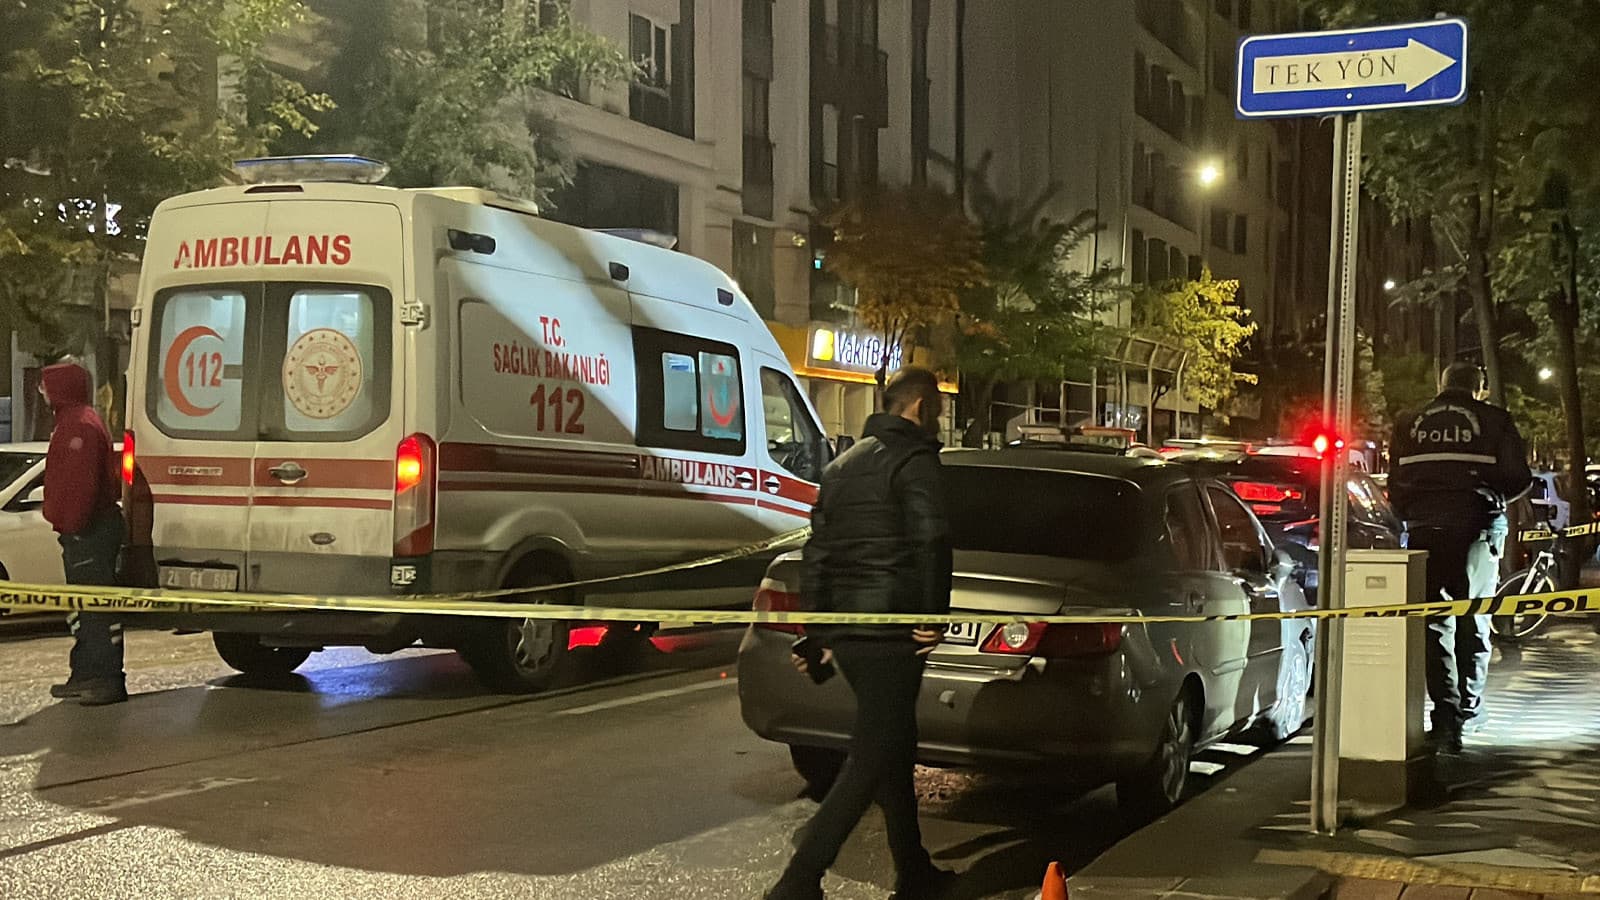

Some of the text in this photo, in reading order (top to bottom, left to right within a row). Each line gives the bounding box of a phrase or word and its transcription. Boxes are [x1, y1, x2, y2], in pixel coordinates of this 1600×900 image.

[1265, 53, 1397, 86] TEK YÖN
[173, 235, 351, 269] AMBULANS
[539, 316, 566, 347] T.C.
[186, 352, 222, 388] 112
[493, 339, 610, 386] SAĞLIK BAKANLIĞI
[530, 383, 585, 434] 112
[1417, 425, 1472, 443] POLİS
[643, 455, 738, 488] AMBULANS
